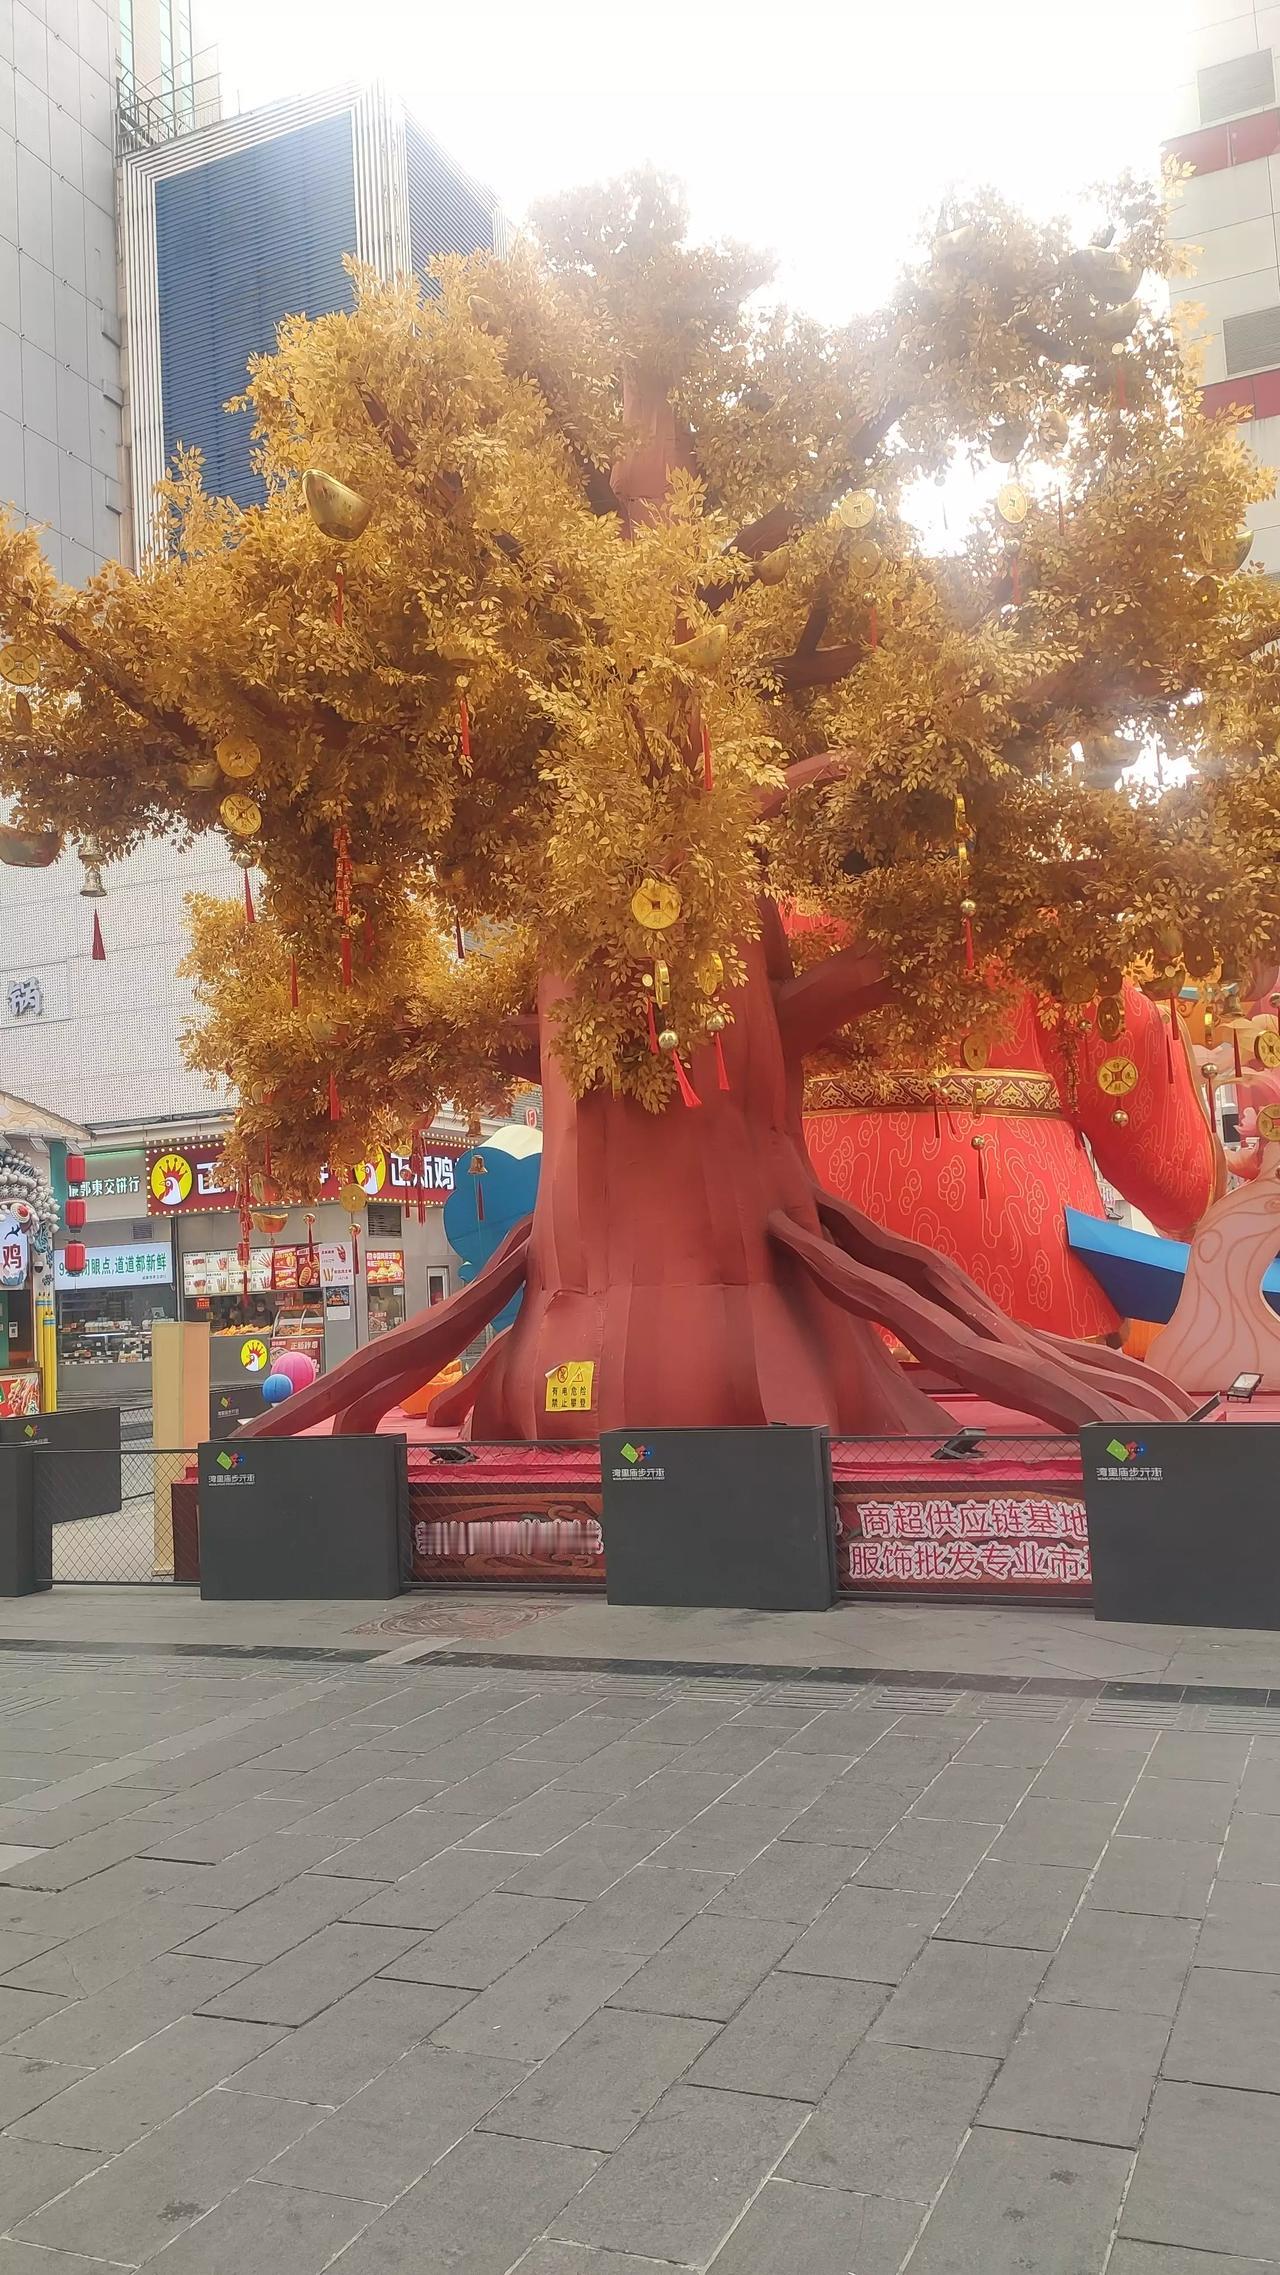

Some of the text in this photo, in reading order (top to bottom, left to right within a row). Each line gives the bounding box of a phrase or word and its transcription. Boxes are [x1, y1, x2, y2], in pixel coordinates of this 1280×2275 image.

[3, 1244, 23, 1270] 鸡
[552, 1386, 587, 1396] 有电危险
[552, 1398, 586, 1408] 禁止攀登
[859, 1502, 1088, 1540] 商超供应链基地
